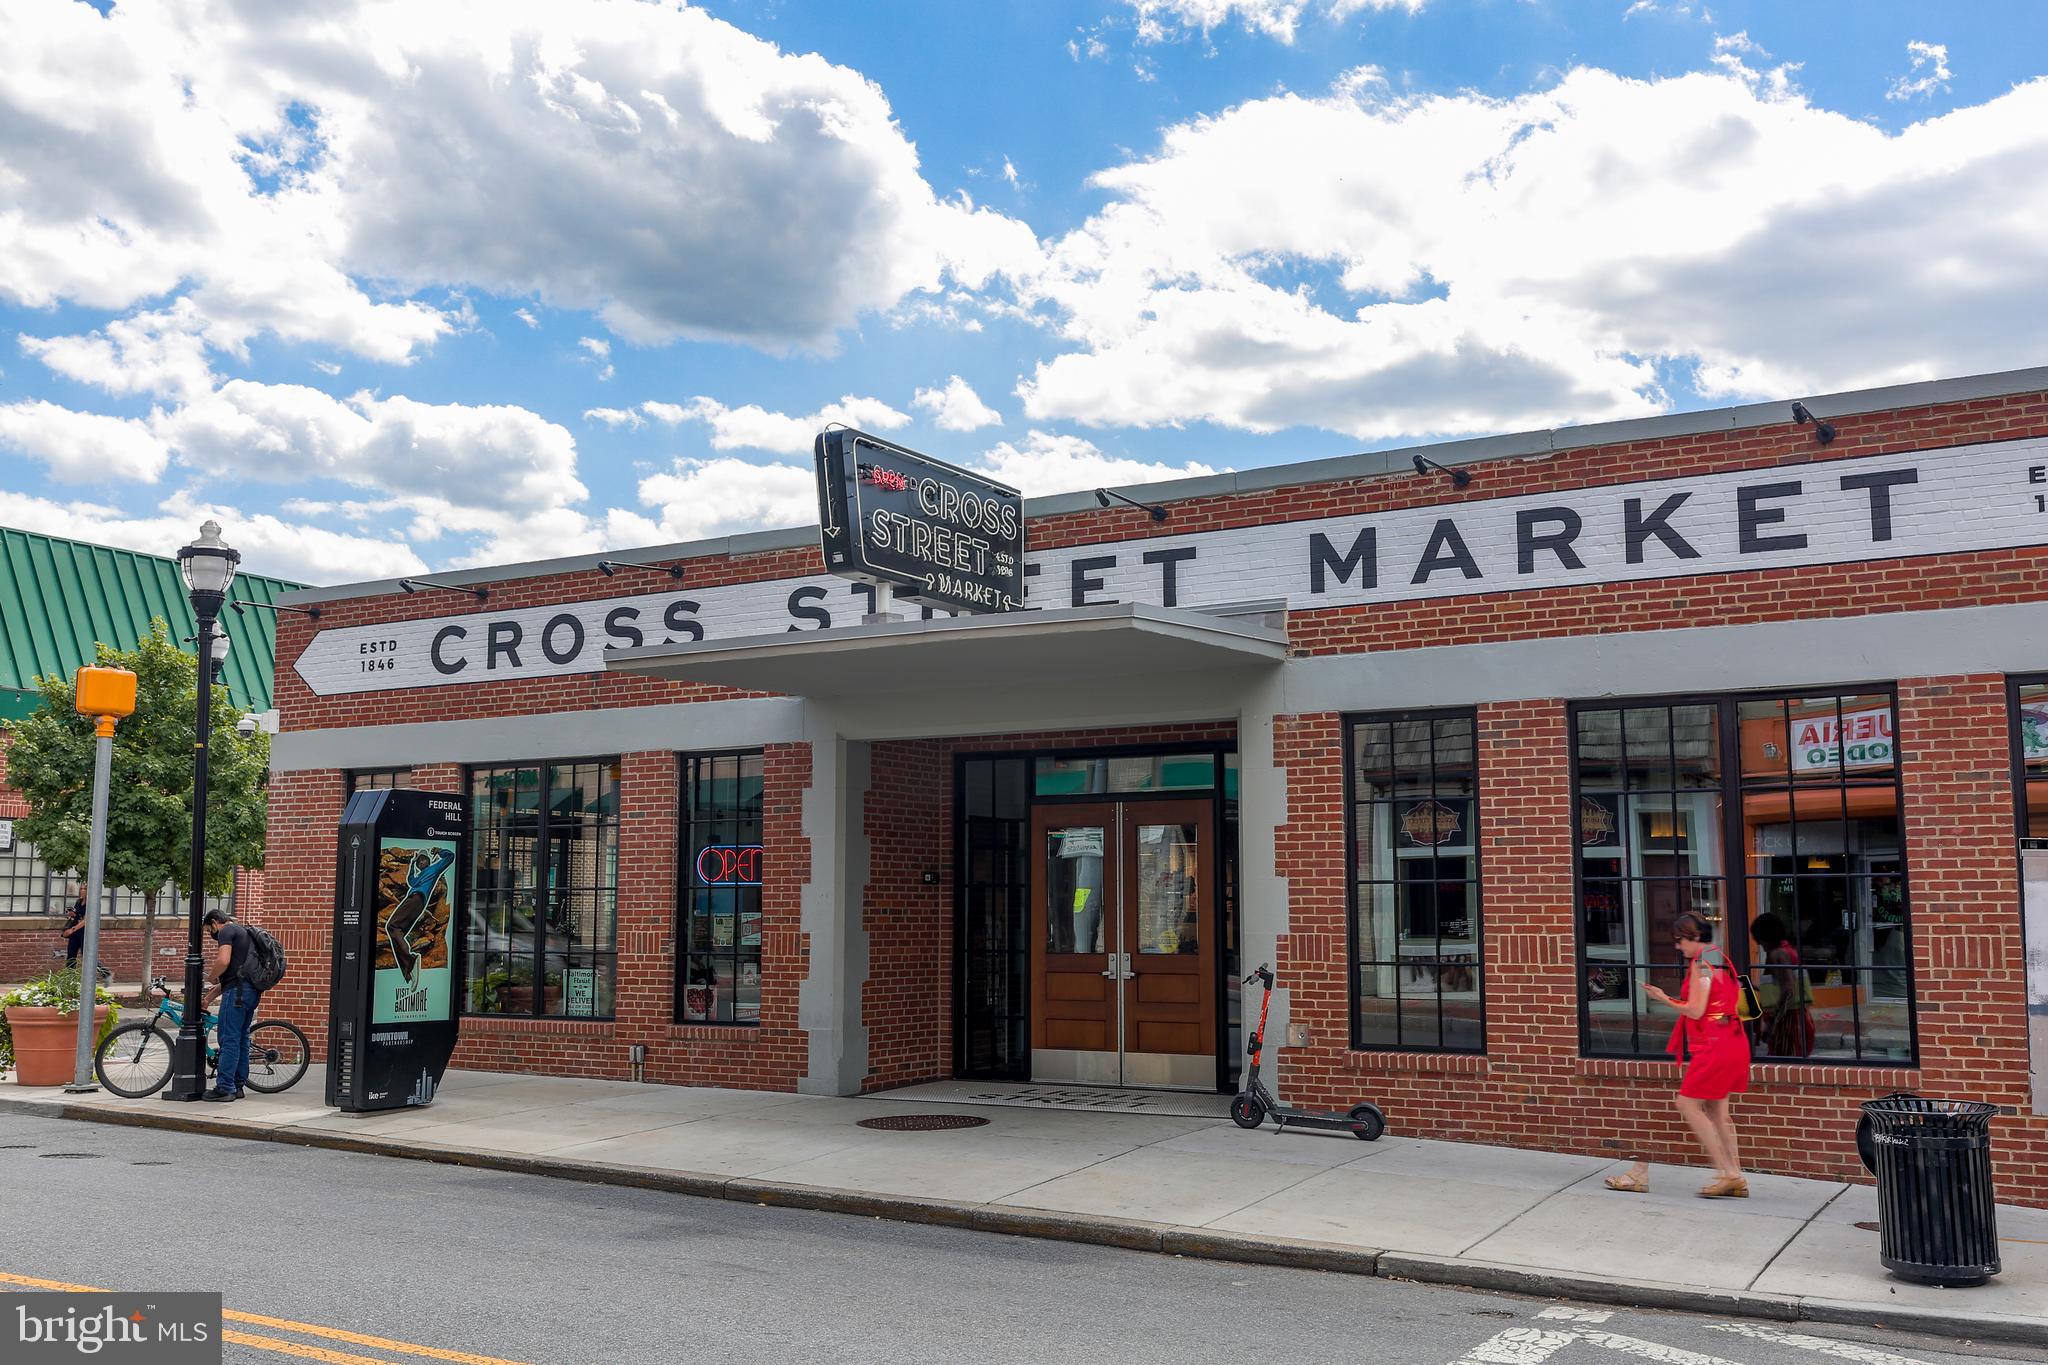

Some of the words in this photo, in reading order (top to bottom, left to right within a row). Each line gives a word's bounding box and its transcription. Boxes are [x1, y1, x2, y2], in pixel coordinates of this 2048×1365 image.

[918, 477, 1017, 541] CROSS
[872, 508, 989, 576] STREET
[430, 599, 704, 675] CROSS
[1309, 468, 1918, 594] MARKET
[937, 572, 1003, 609] MARKET
[360, 639, 398, 655] ESTD
[361, 657, 394, 673] 1846
[428, 800, 462, 811] FEDERAL
[445, 812, 462, 822] HILL
[394, 987, 428, 1013] BALTIMORE
[395, 988, 410, 1001] VISIT
[371, 1031, 409, 1042] DOWNTOWN
